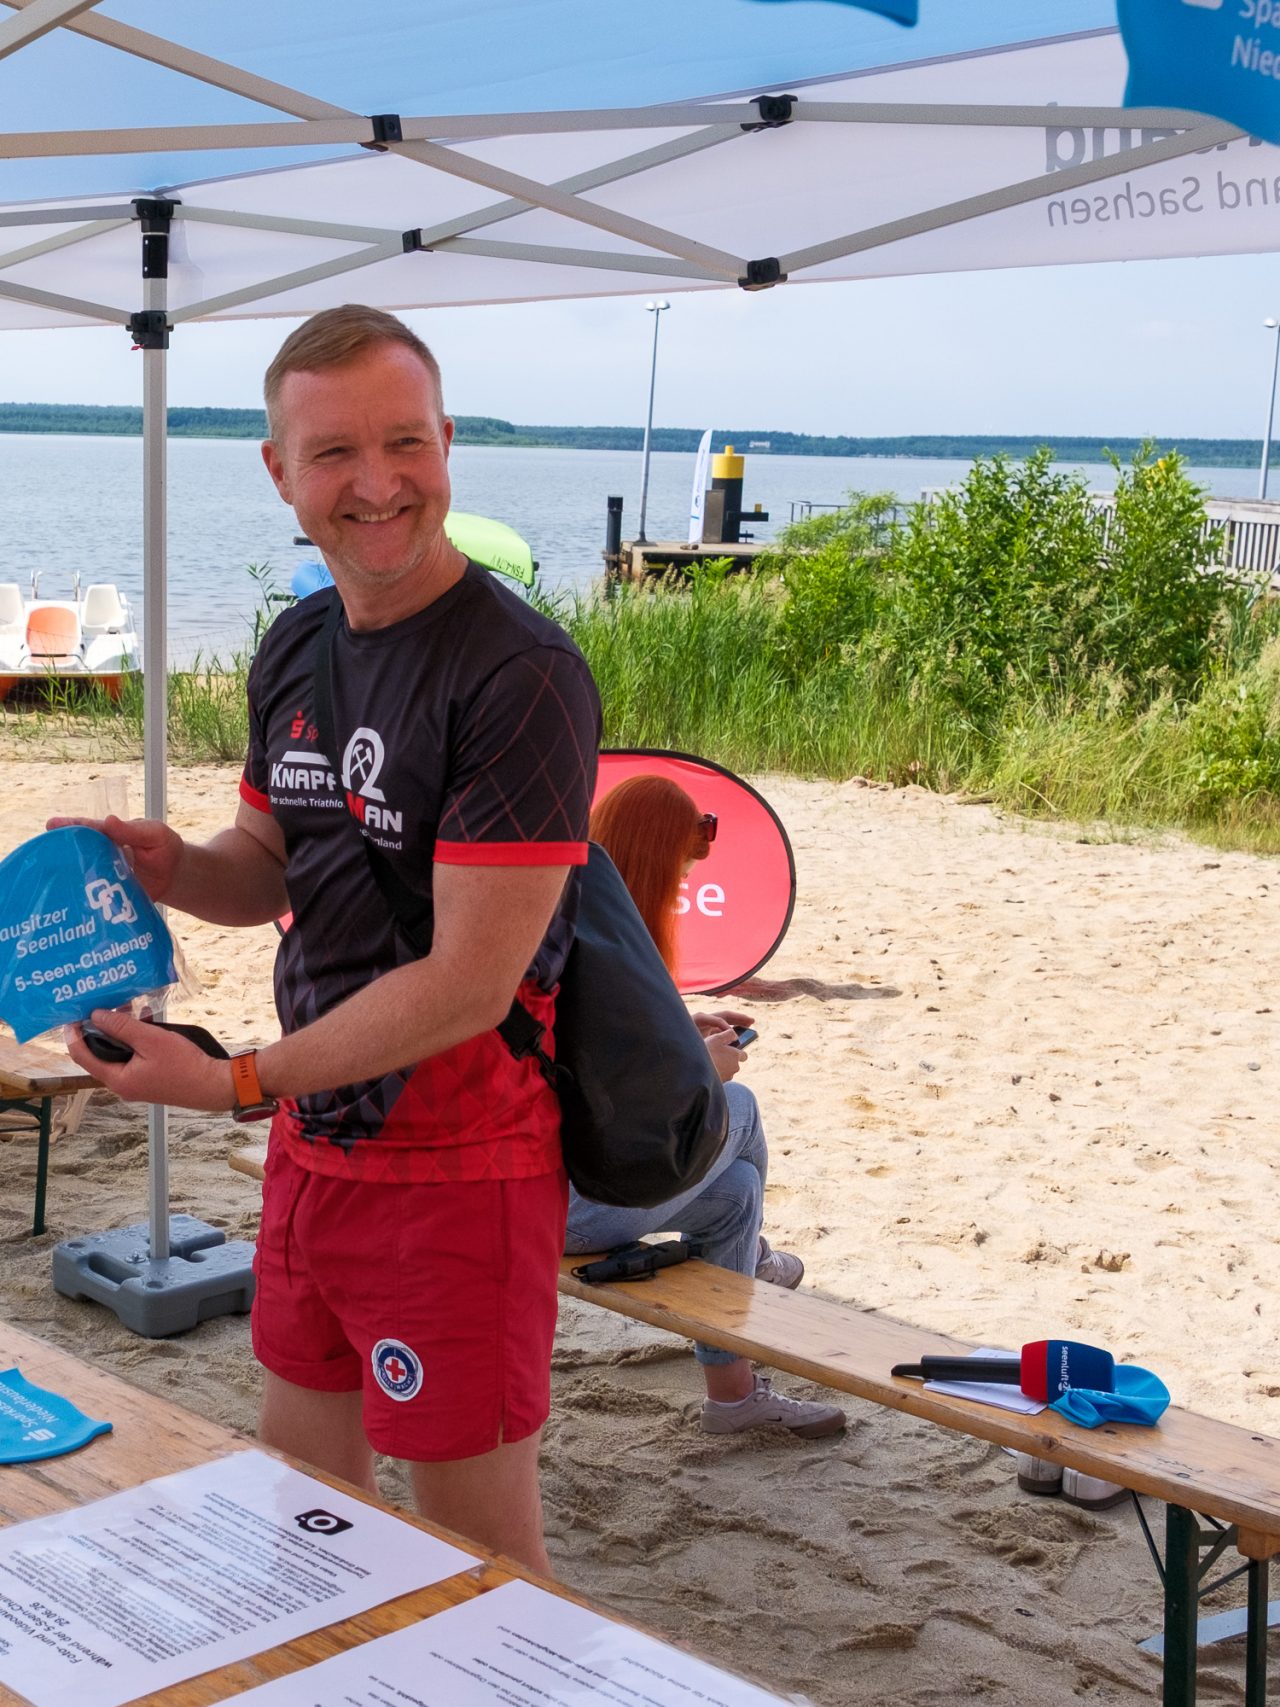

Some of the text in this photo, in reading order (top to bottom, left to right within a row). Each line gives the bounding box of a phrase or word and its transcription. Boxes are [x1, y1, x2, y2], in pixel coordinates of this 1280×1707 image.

[308, 798, 346, 809] Triathlo
[16, 915, 97, 959] Seenland
[14, 931, 154, 993] 5-Seen-Challenge
[52, 960, 138, 1004] 29.06.2026
[32, 1633, 57, 1646] und
[52, 1630, 74, 1642] der
[53, 1645, 84, 1664] Foto-
[66, 1641, 115, 1668] während
